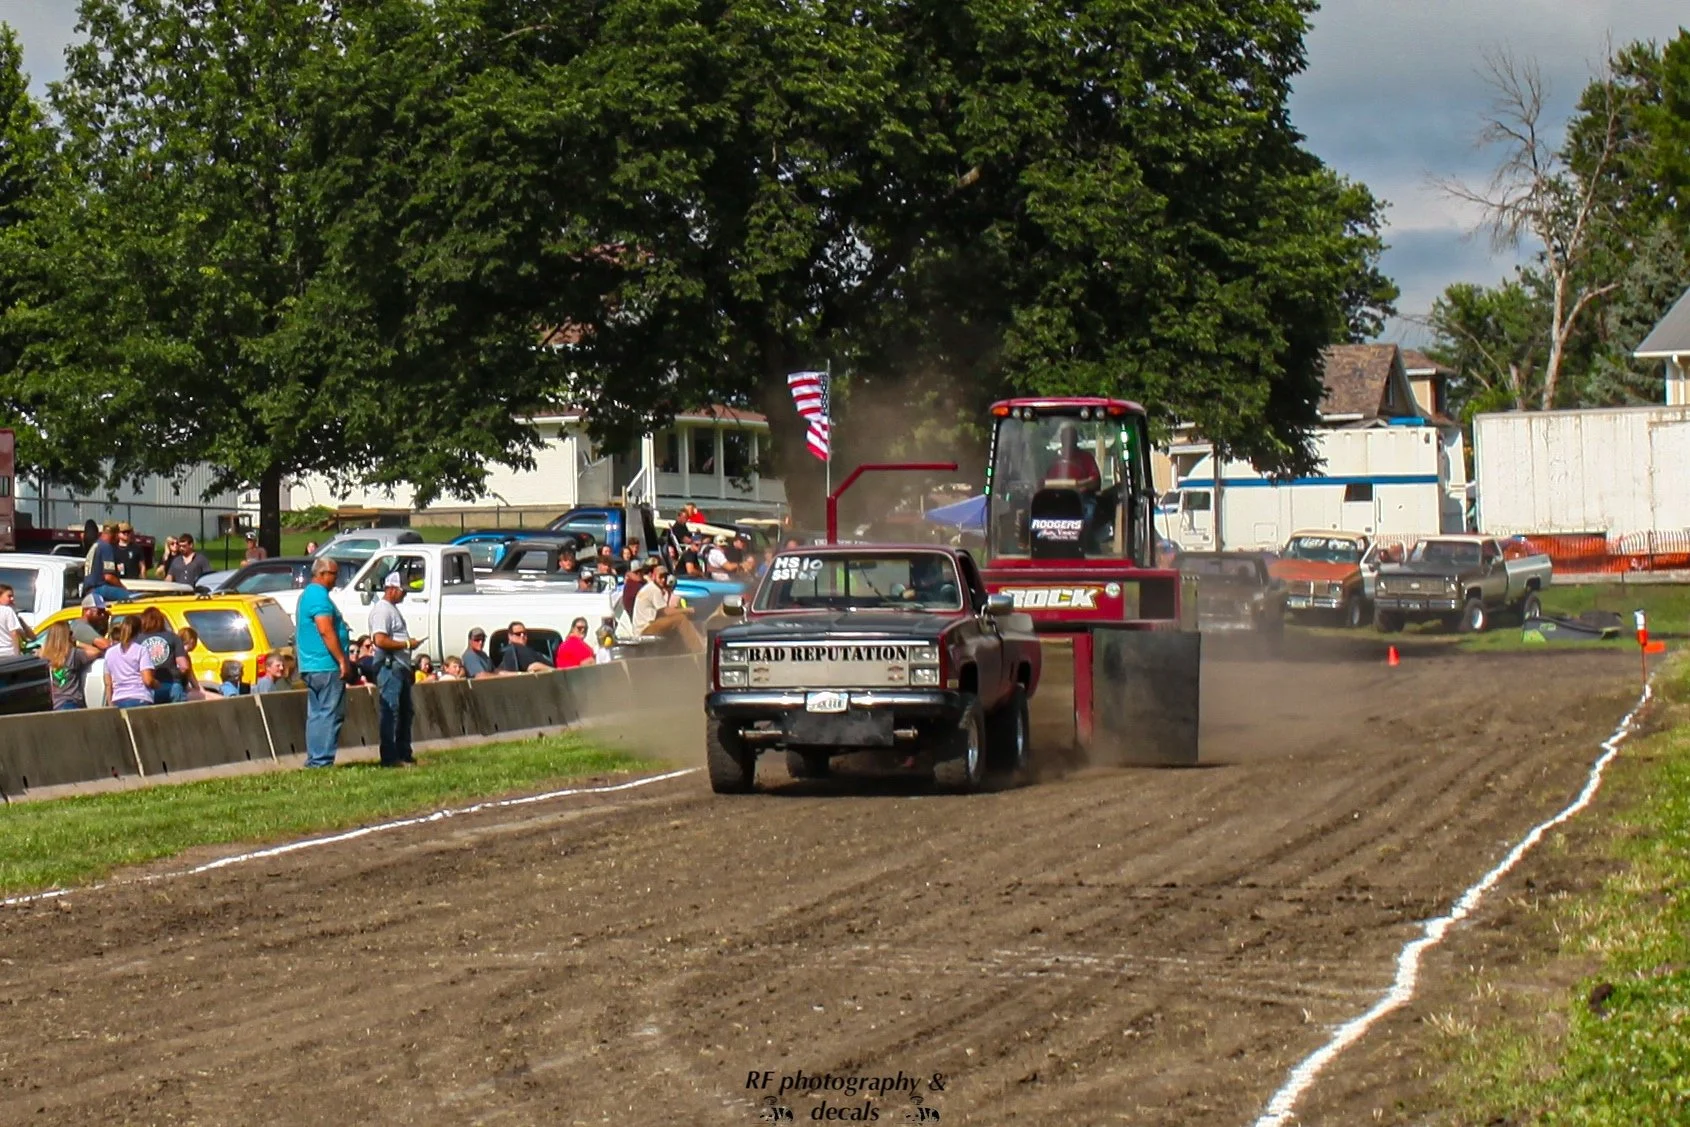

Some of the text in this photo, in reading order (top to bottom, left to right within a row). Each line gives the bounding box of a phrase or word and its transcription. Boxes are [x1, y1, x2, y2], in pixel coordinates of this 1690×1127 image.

[1031, 519, 1082, 530] RODGERS
[775, 556, 800, 569] HS
[771, 568, 798, 581] SST
[749, 646, 907, 662] BAD REPUTATION
